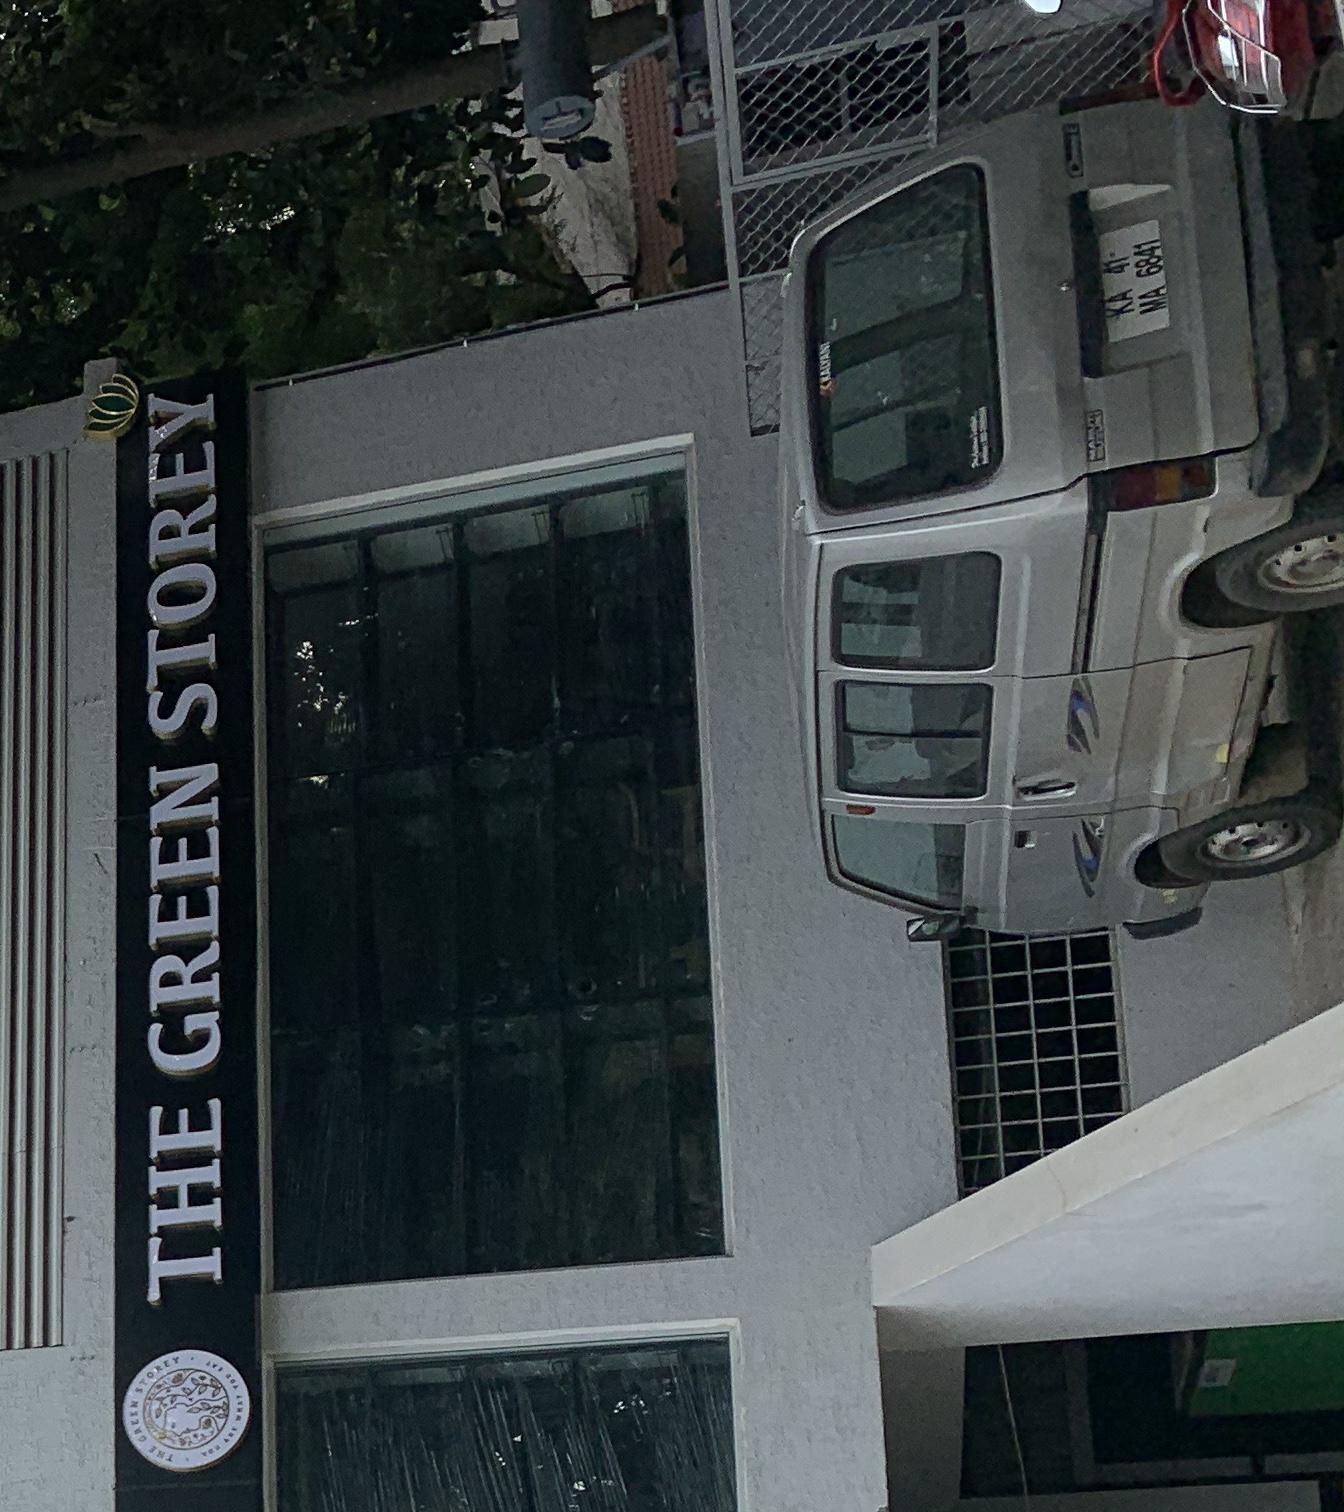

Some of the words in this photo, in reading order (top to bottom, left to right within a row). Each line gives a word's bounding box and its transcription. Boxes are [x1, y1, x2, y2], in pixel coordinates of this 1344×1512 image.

[1103, 288, 1135, 319] KA
[1132, 238, 1164, 278] 6841
[1137, 285, 1168, 316] MA
[145, 392, 220, 740] STOREY
[146, 761, 224, 1077] GREEN
[146, 1097, 224, 1306] THE
